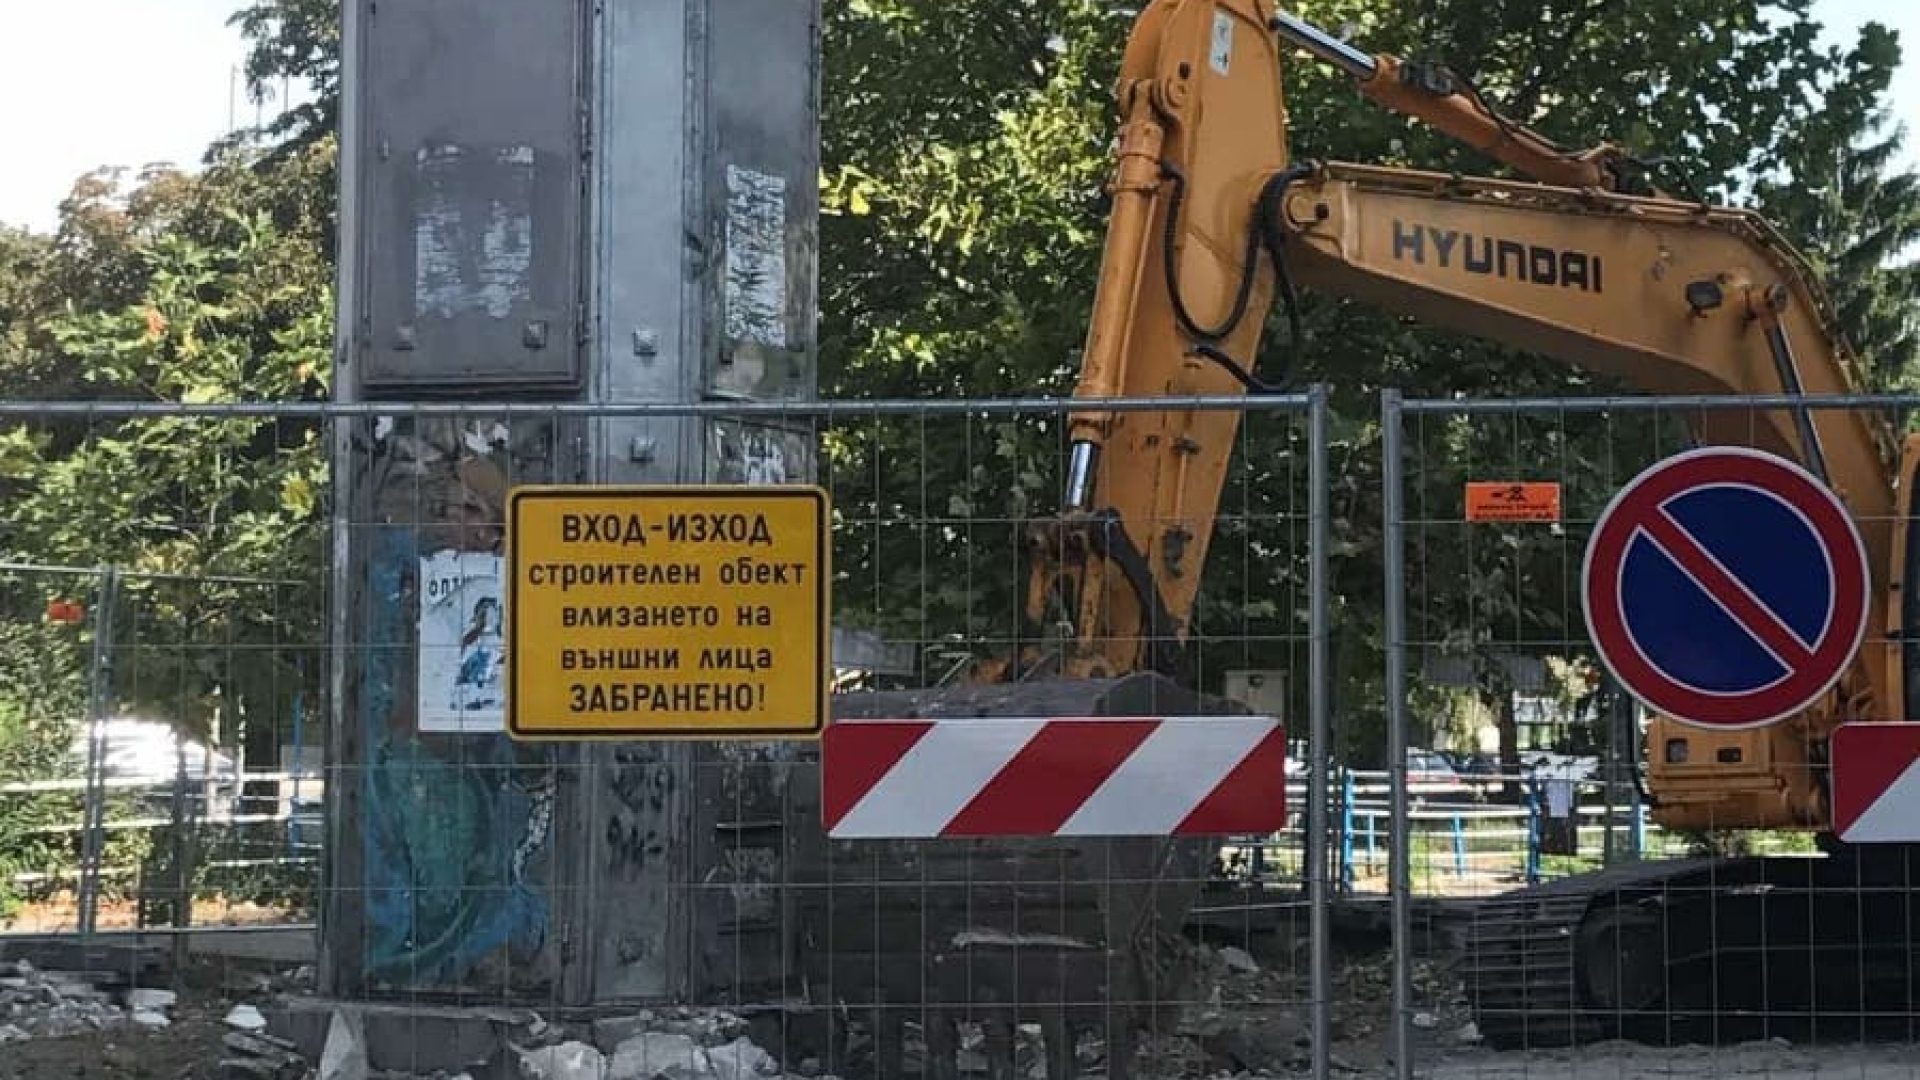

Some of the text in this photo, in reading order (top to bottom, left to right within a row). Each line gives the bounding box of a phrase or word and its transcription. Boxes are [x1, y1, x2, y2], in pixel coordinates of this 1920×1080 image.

[1393, 220, 1603, 294] HYUNDAI
[562, 513, 773, 547] ВХОД-ИЗХОД
[528, 556, 807, 592] строителен обект
[562, 605, 771, 628] влизането на
[561, 647, 773, 673] външни лица
[569, 682, 765, 713] ЗАБРАНЕНО!
